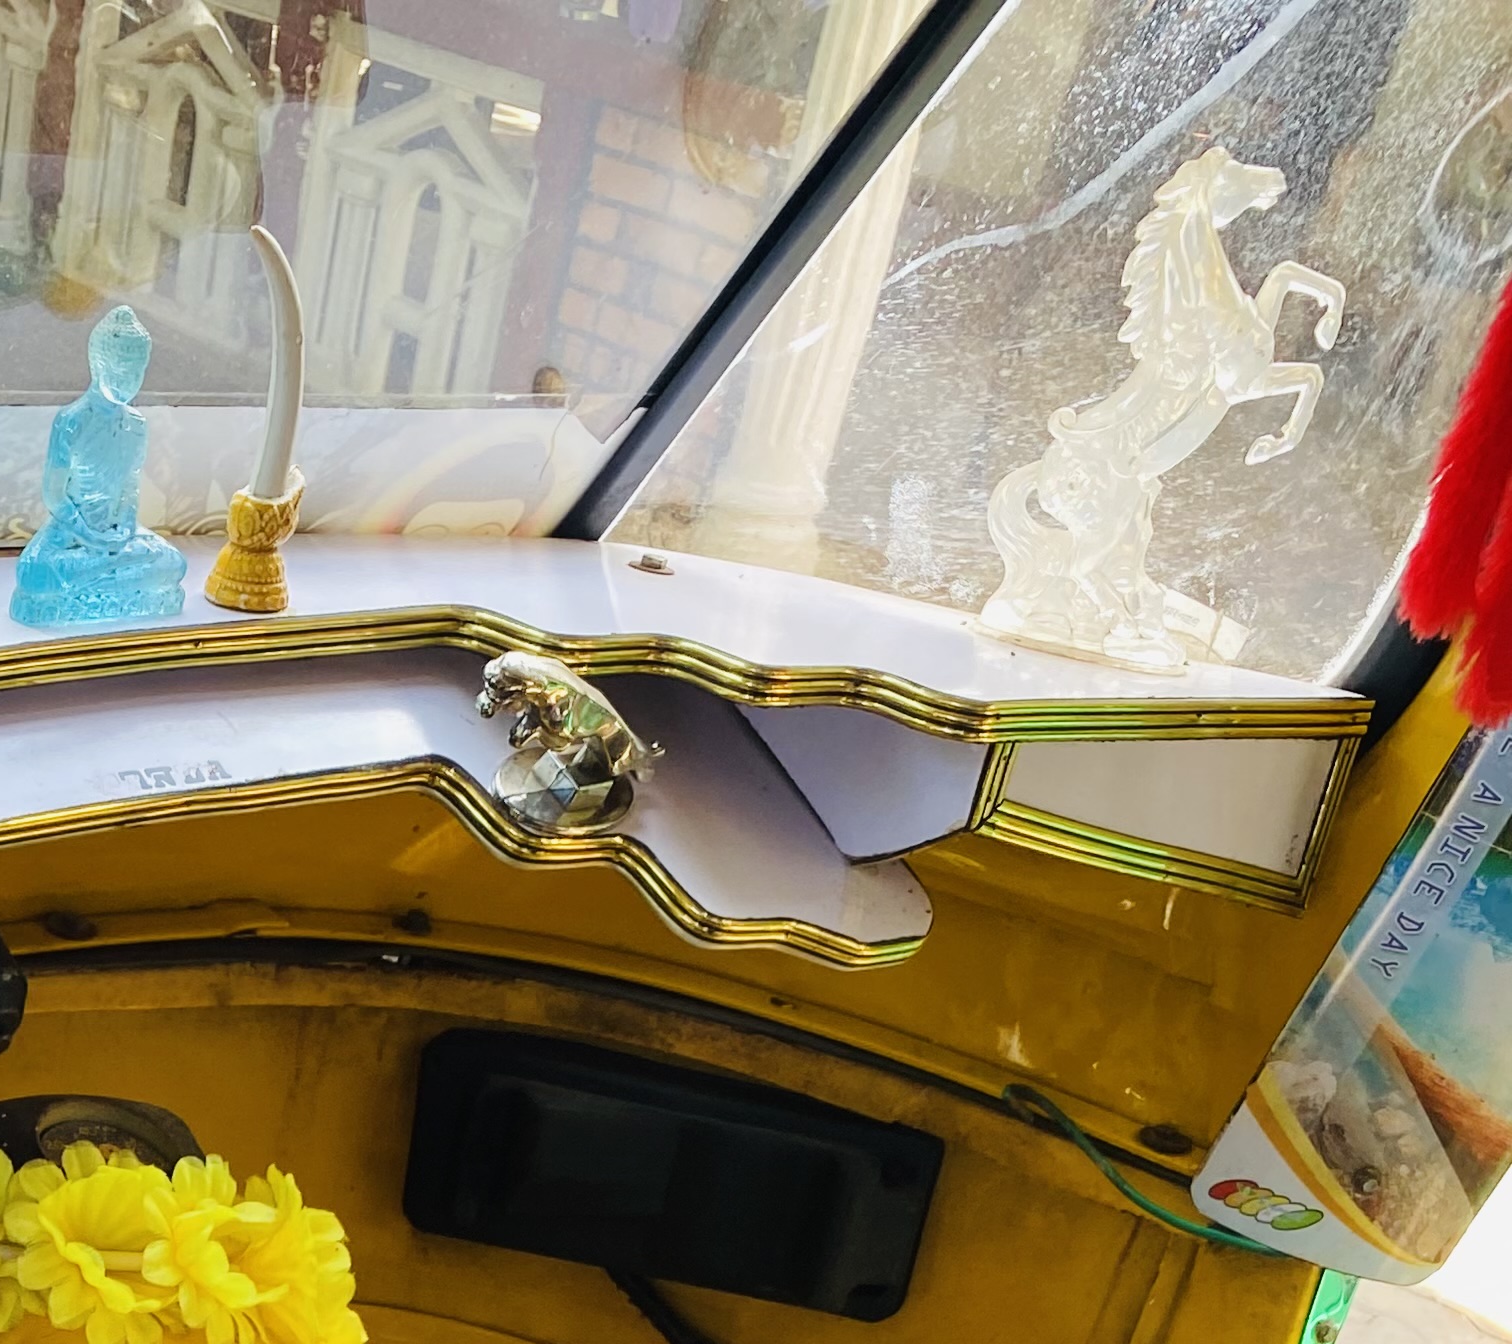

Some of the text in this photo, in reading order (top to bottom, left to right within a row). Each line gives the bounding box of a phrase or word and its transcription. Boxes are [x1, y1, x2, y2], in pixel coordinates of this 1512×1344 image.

[1370, 781, 1504, 978] A NICE DAY
